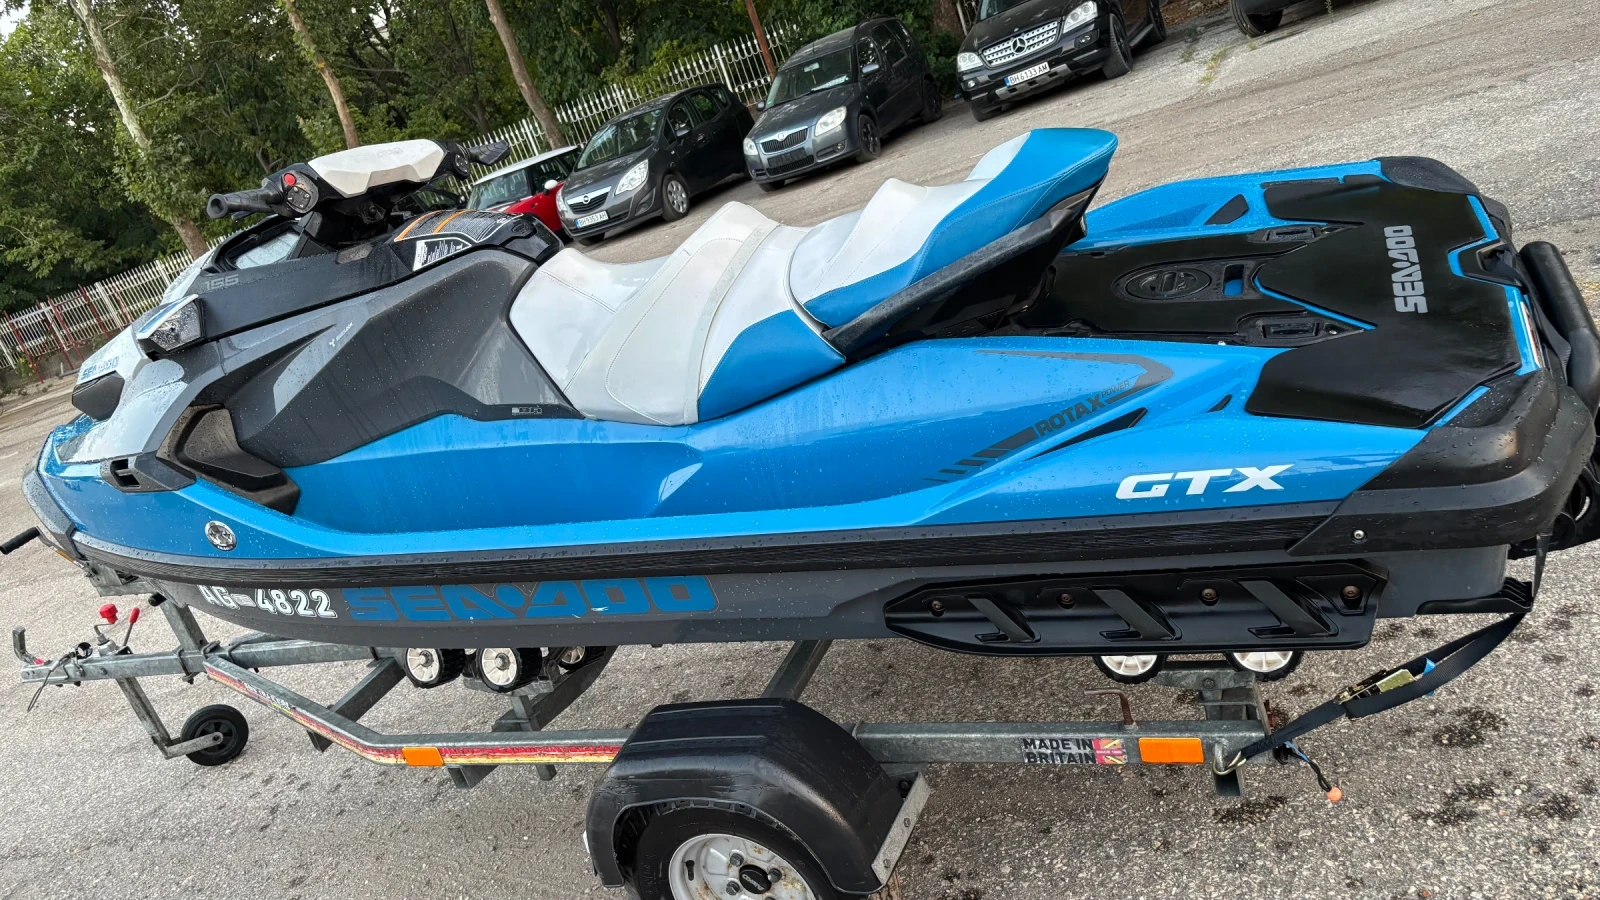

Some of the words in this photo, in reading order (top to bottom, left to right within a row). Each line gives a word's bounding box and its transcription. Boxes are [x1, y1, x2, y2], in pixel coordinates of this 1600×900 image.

[1020, 68, 1037, 80] 6133
[1038, 63, 1048, 75] AM
[205, 274, 239, 290] 155
[1035, 394, 1105, 436] ROTAX
[1101, 380, 1130, 398] POWER
[1115, 463, 1295, 500] GTX
[1022, 738, 1073, 750] MADE
[1076, 738, 1094, 750] IN
[1025, 752, 1097, 764] BRITAIN
